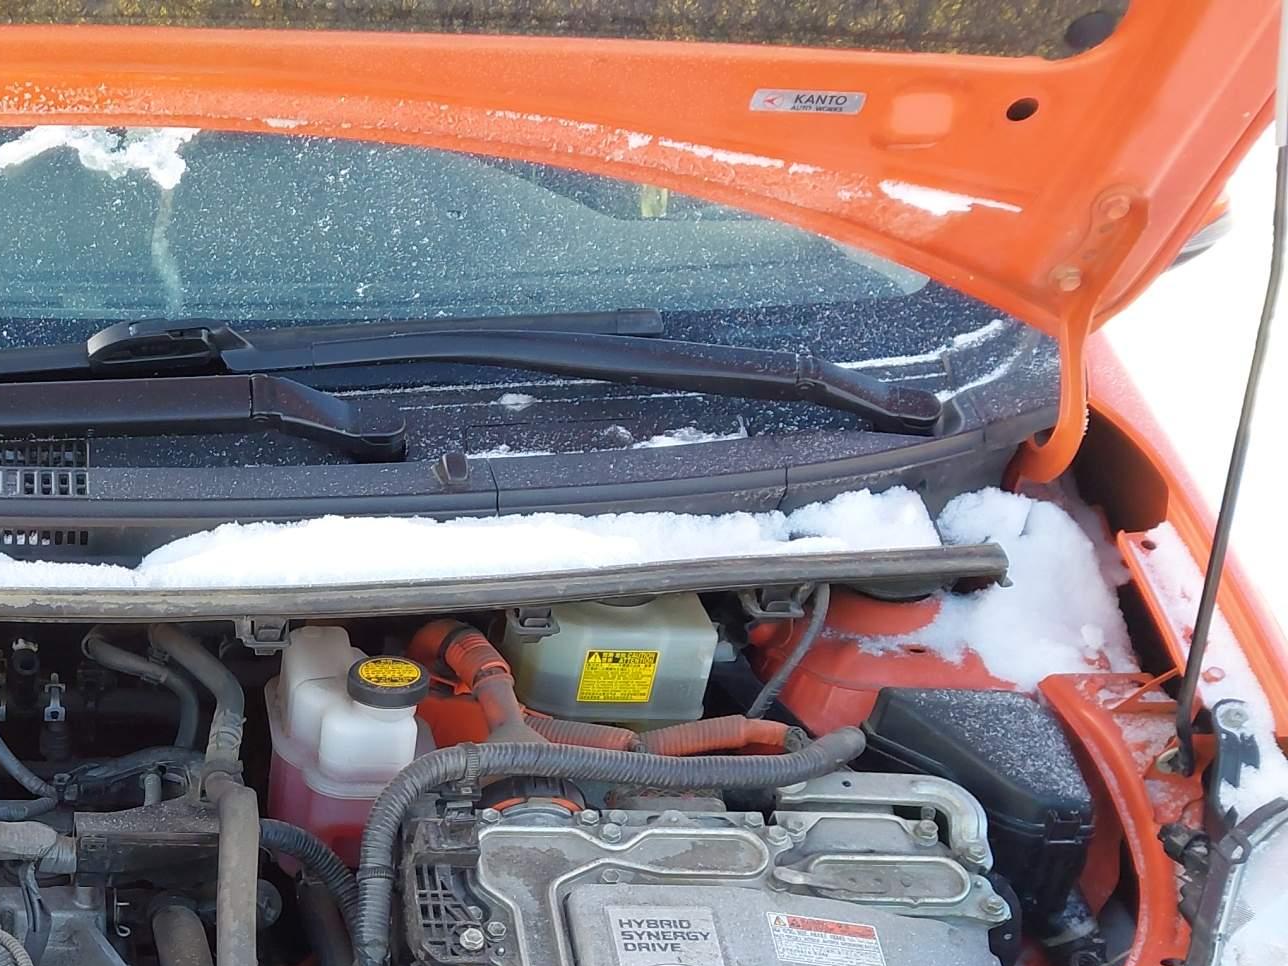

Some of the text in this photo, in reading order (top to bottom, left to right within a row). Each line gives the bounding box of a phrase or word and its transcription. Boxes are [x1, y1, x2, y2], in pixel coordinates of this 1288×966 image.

[794, 94, 848, 106] KANTO
[618, 919, 692, 930] HYBRID
[621, 930, 711, 941] SYNERGY
[623, 942, 681, 952] DRIVE
